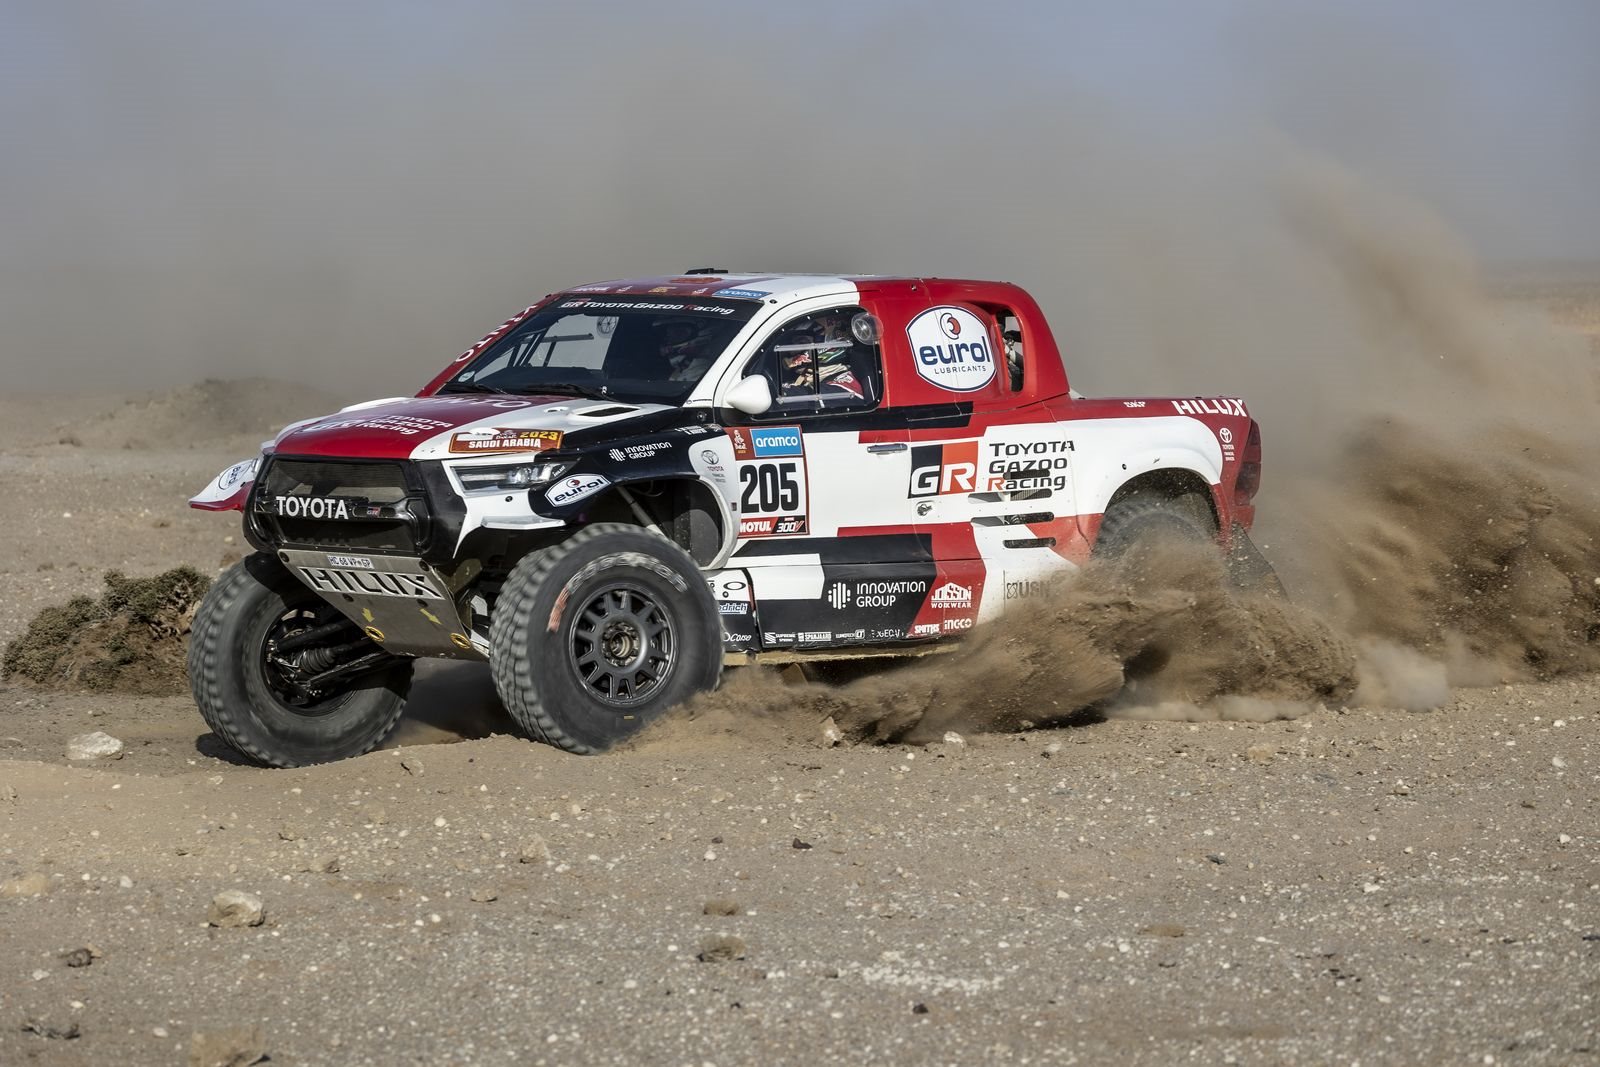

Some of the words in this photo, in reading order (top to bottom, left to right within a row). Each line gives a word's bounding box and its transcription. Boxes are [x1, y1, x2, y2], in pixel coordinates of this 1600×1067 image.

[718, 289, 763, 298] aramco
[584, 301, 632, 309] TOYOTA
[633, 302, 683, 310] GAZOO
[684, 303, 735, 315] Racing
[919, 335, 991, 366] eurol
[934, 365, 987, 374] LUBRICANTS
[1171, 399, 1247, 417] HILUX
[361, 420, 420, 435] Racing
[371, 418, 434, 430] GAZOO
[384, 415, 454, 428] TOYOTA
[520, 431, 559, 440] 2023
[755, 436, 798, 448] aramco
[469, 440, 500, 448] SAUDI
[503, 438, 541, 448] ARABIA
[624, 441, 672, 453] INNOVATION
[989, 440, 1075, 457] TOYOTA
[628, 450, 655, 459] GROUP
[989, 458, 1068, 474] GAZOO
[911, 462, 976, 495] GR
[988, 476, 1066, 491] Racing
[554, 479, 604, 502] eurol
[740, 462, 799, 513] 205
[276, 496, 349, 519] TOYOTA
[740, 521, 772, 533] MOTUL
[776, 520, 805, 533] 300V
[329, 556, 339, 565] HC
[300, 567, 443, 599] HILUX
[856, 581, 926, 594] INNOVATION
[856, 595, 896, 608] GROUP
